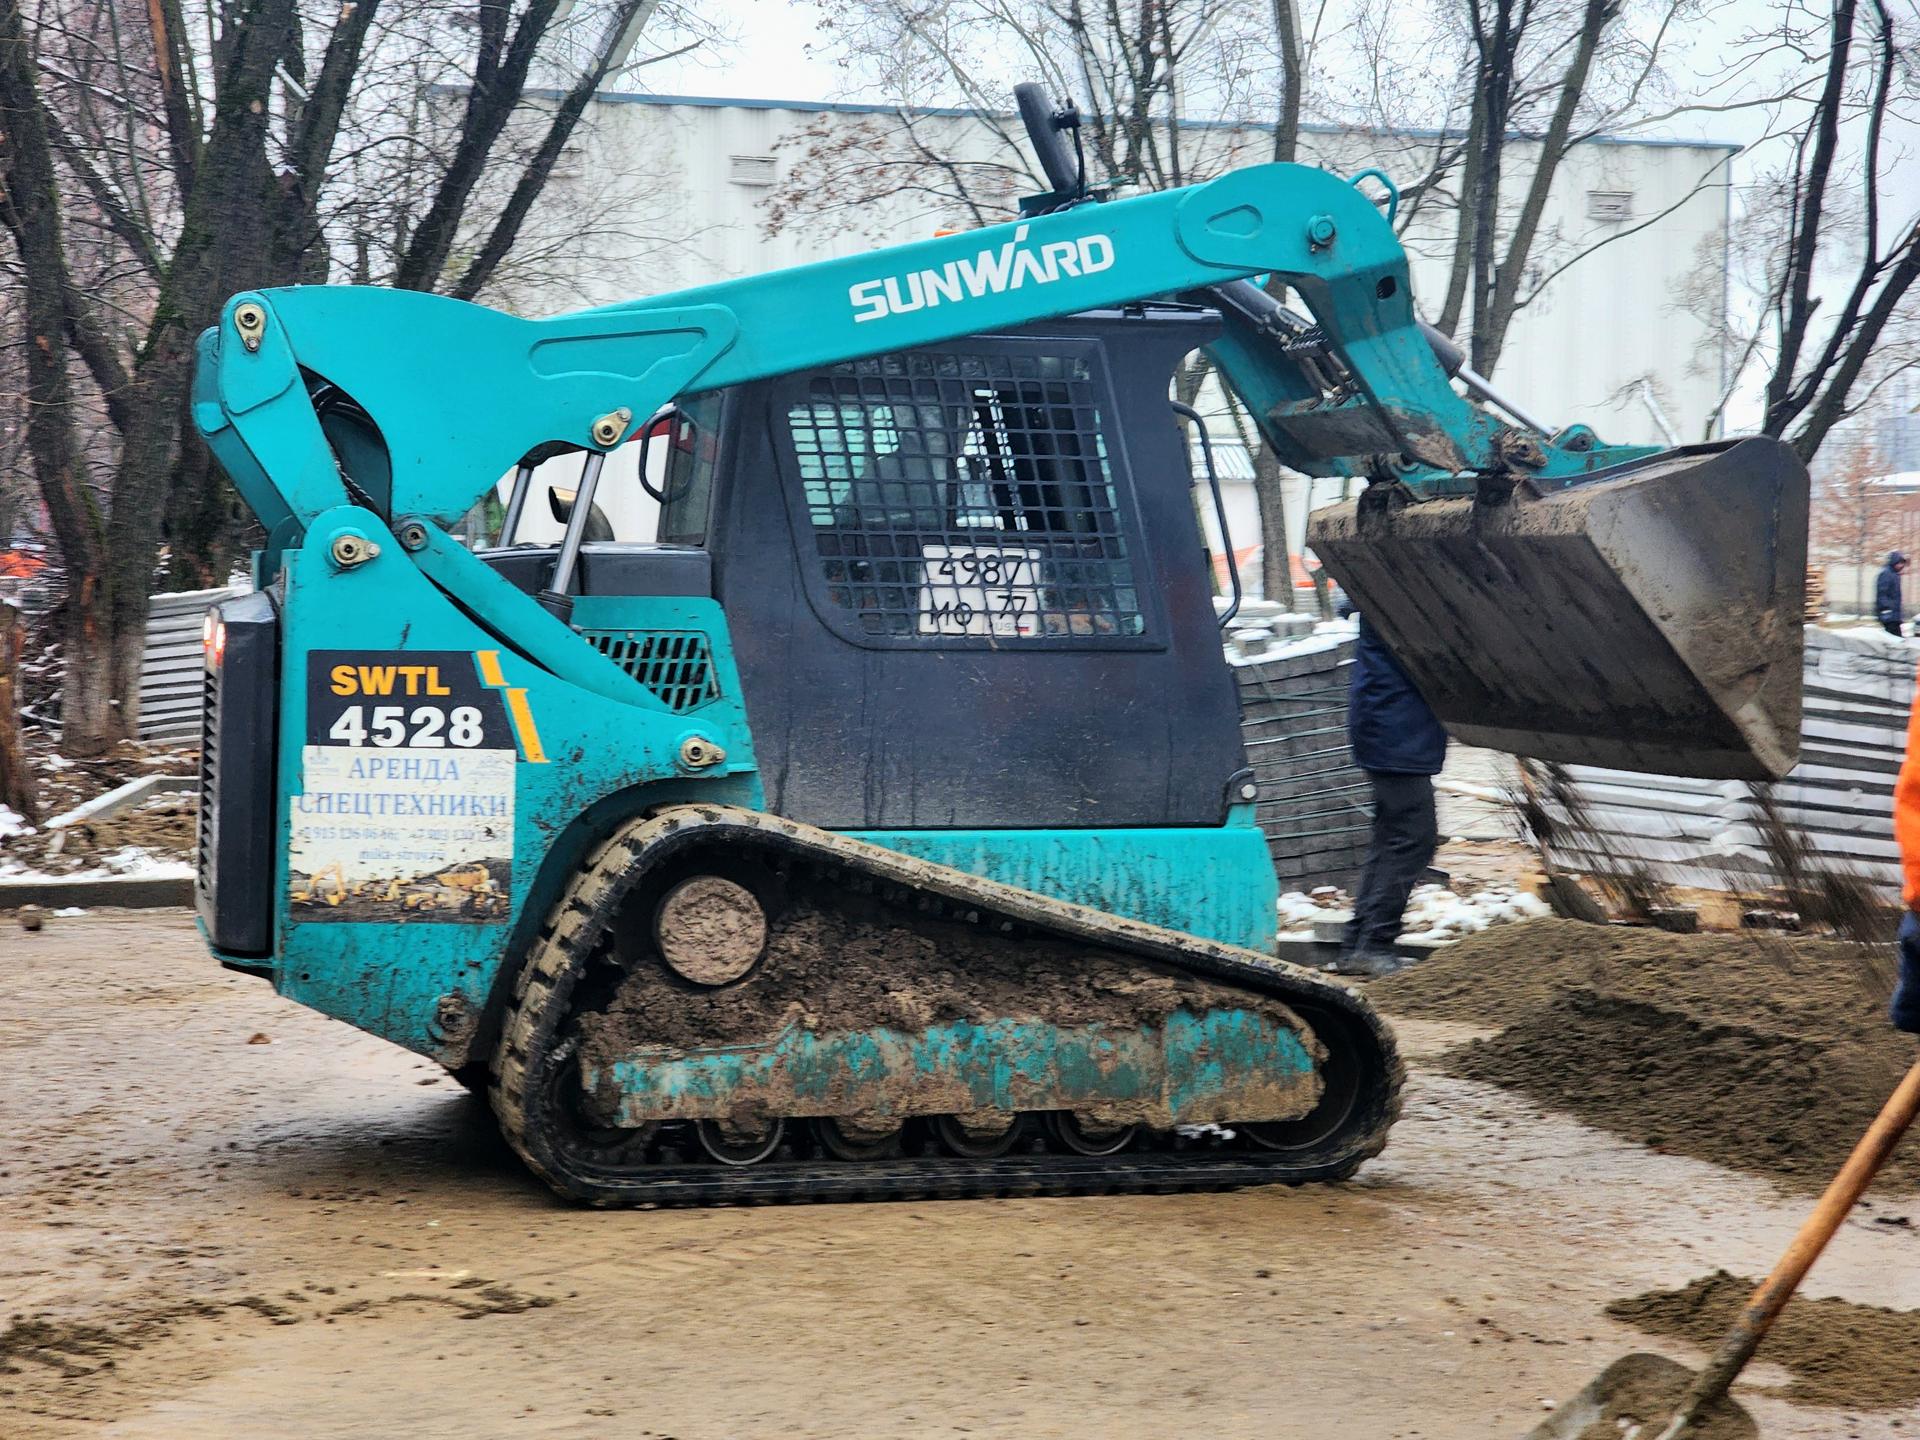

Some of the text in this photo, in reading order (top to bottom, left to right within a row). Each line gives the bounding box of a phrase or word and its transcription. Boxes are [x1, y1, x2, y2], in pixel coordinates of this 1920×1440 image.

[849, 224, 1115, 323] SUNWARD
[938, 552, 1023, 585] 4987
[997, 594, 1028, 622] 77
[330, 664, 451, 697] SWTL
[329, 705, 484, 748] 4528
[347, 757, 460, 783] АРЕНДА
[299, 792, 507, 818] СПЕЦТЕХНИКИ
